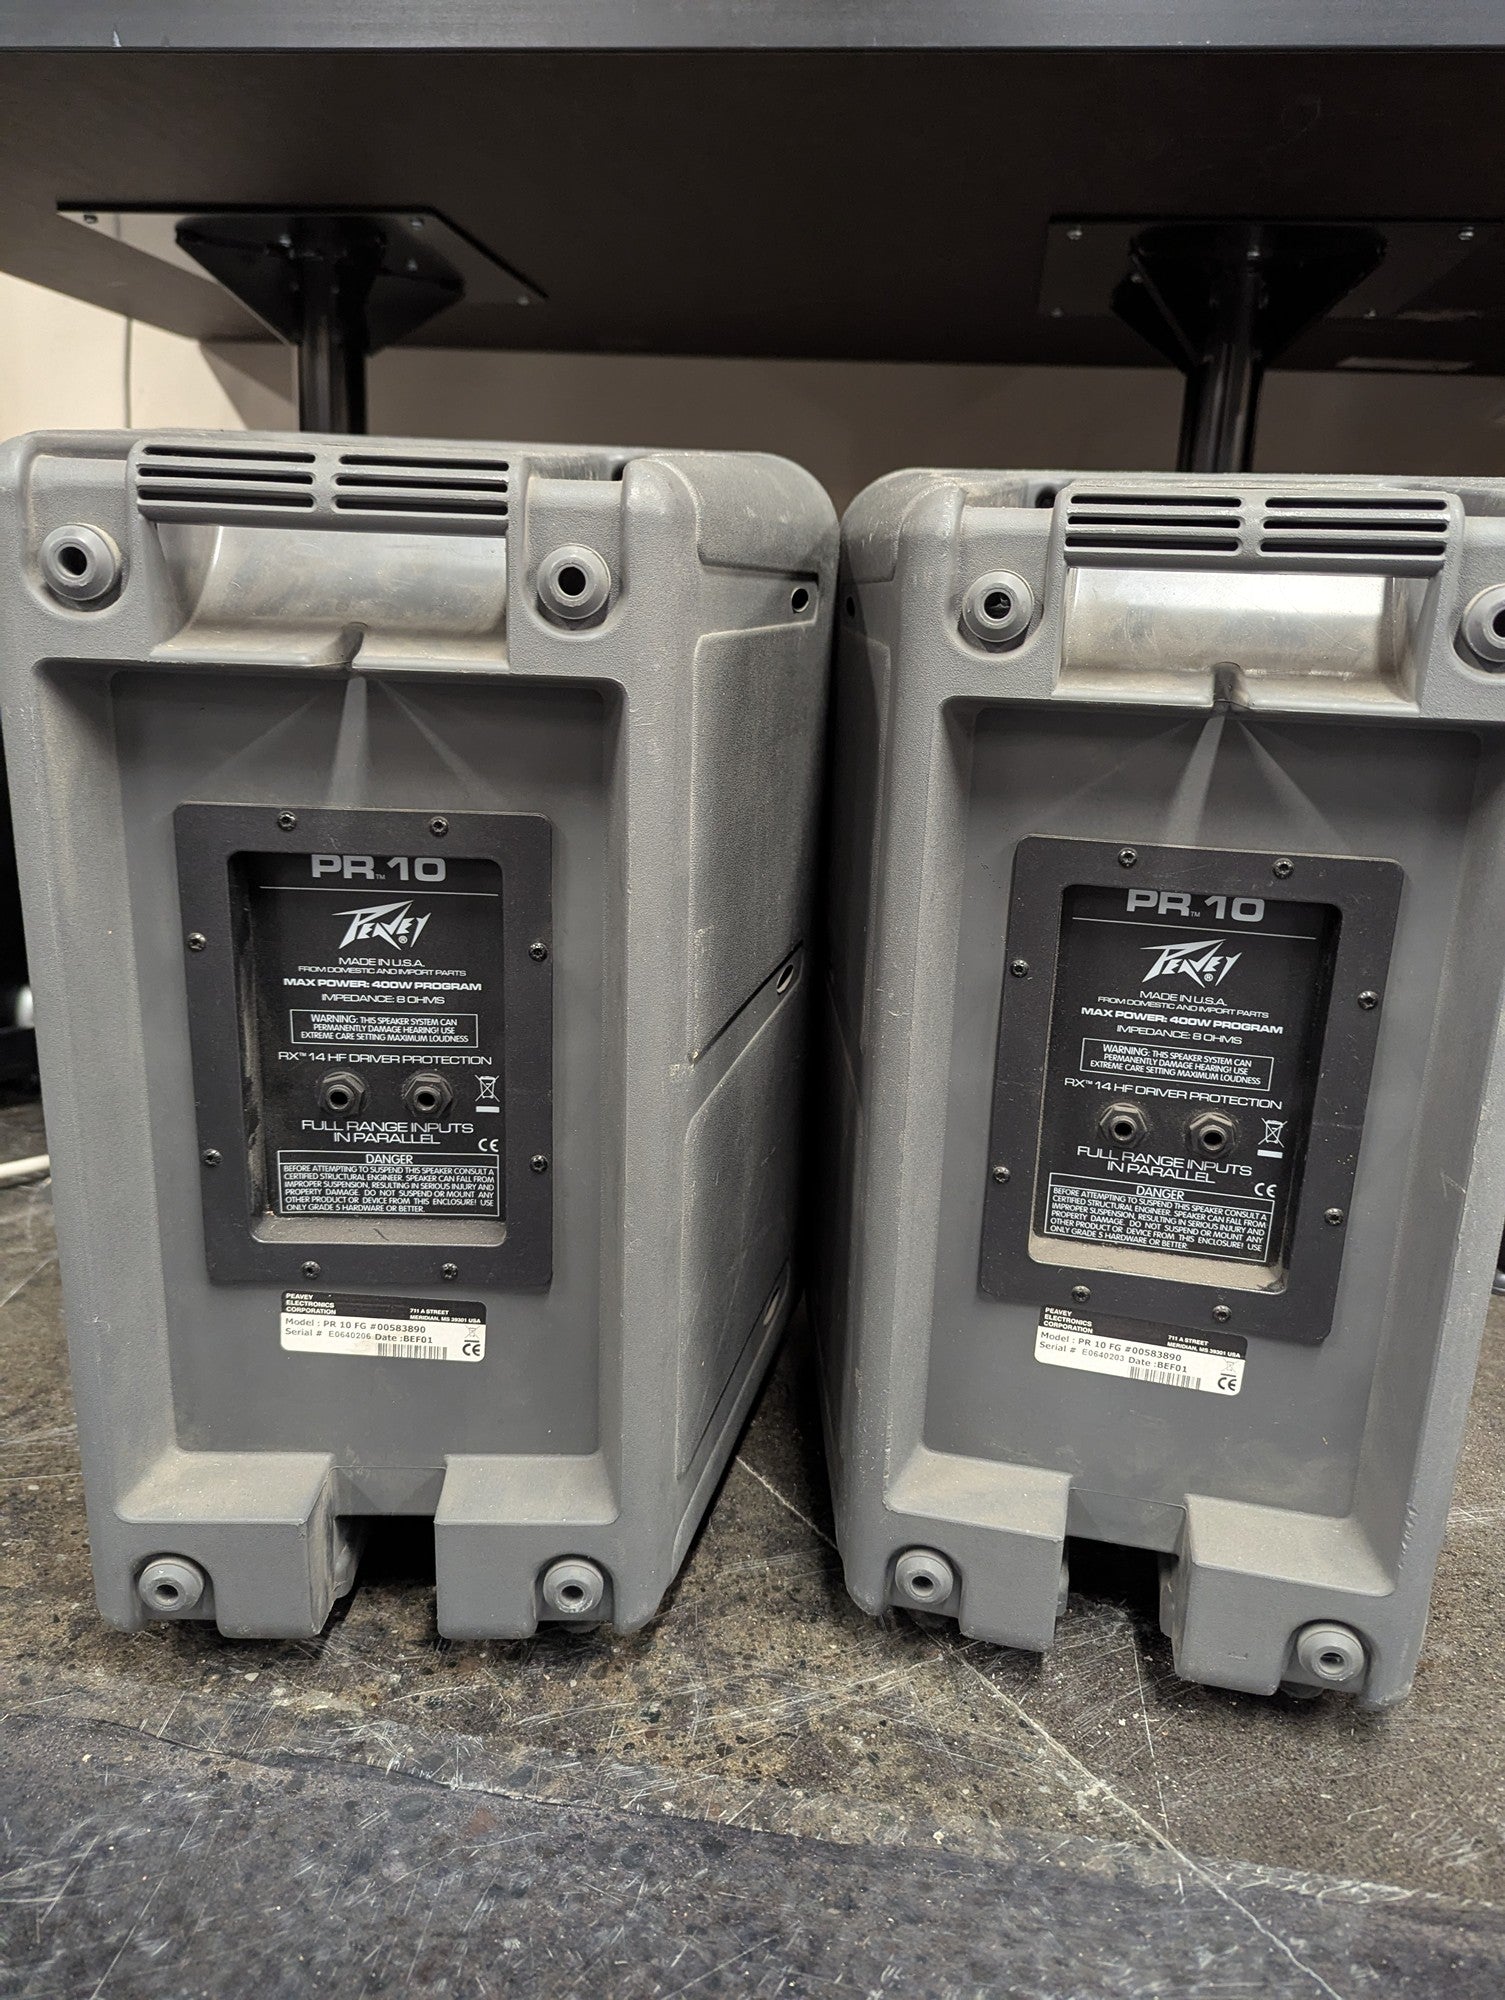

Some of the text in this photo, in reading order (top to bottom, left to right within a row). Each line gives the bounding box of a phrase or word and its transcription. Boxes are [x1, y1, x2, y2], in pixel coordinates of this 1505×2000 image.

[387, 857, 446, 882] 10
[1205, 896, 1265, 922] 10
[392, 959, 425, 967] U.S.A.
[318, 979, 369, 988] POWER:
[372, 981, 413, 989] 400W
[415, 982, 481, 990] PROGRAM
[322, 994, 394, 1003] IMPEDANCE:
[407, 996, 445, 1004] OHMS
[1140, 991, 1227, 1006] MADE IN U.S.A.
[1127, 999, 1174, 1009] DOMESTIC
[1176, 1003, 1197, 1011] AND
[1199, 1005, 1235, 1015] IMPORT
[1237, 1009, 1269, 1018] PARTS
[311, 1014, 358, 1023] WARNING:
[377, 1017, 409, 1025] SPEAKER
[411, 1018, 439, 1026] SYSTEM
[1081, 1007, 1283, 1034] MAX POWER: 400W PROGRAM
[314, 1024, 366, 1032] PERMANENTLY
[1117, 1025, 1190, 1039] IMPEDANCE:
[1203, 1033, 1242, 1044] OHMS
[309, 1053, 326, 1062] 14
[328, 1054, 347, 1062] HF
[350, 1055, 400, 1063] DRIVER
[403, 1056, 492, 1065] PROTECTION
[1103, 1044, 1251, 1067] WARNING: THIS SPEAKER SYSTEM CAN
[1104, 1053, 1248, 1075] PERMANENTLY DAMAGE HEARING! USE
[1090, 1060, 1261, 1085] EXTREME CARE SETTING MAXIMUM LOUDNESS
[1095, 1082, 1112, 1090] 14
[1114, 1084, 1133, 1092] HF
[1135, 1086, 1187, 1099] DRIVER
[1189, 1091, 1282, 1109] PROTECTION
[302, 1120, 473, 1133] FULL RANGE INPUTS
[334, 1133, 440, 1144] IN PARALLEL
[366, 1154, 413, 1164] DANGER
[1077, 1146, 1252, 1176] FULL RANGE INPUTS
[1107, 1161, 1215, 1184] IN PARALLEL
[1053, 1187, 1138, 1203] BEFORE ATTEMPTING TO
[1136, 1186, 1184, 1199] DANGER
[286, 1307, 336, 1315] CORPORATION
[1045, 1308, 1072, 1316] PEAVEY
[286, 1318, 314, 1326] Model
[370, 1323, 425, 1333] #00583890
[1044, 1314, 1092, 1326] ELECTRONICS
[1044, 1321, 1093, 1334] CORPORATION
[285, 1328, 312, 1336] Serial
[1039, 1341, 1066, 1352] Serial
[1128, 1357, 1150, 1366] Date
[1041, 1332, 1069, 1342] Model
[1079, 1338, 1091, 1346] PR
[1125, 1346, 1181, 1361] #00583890
